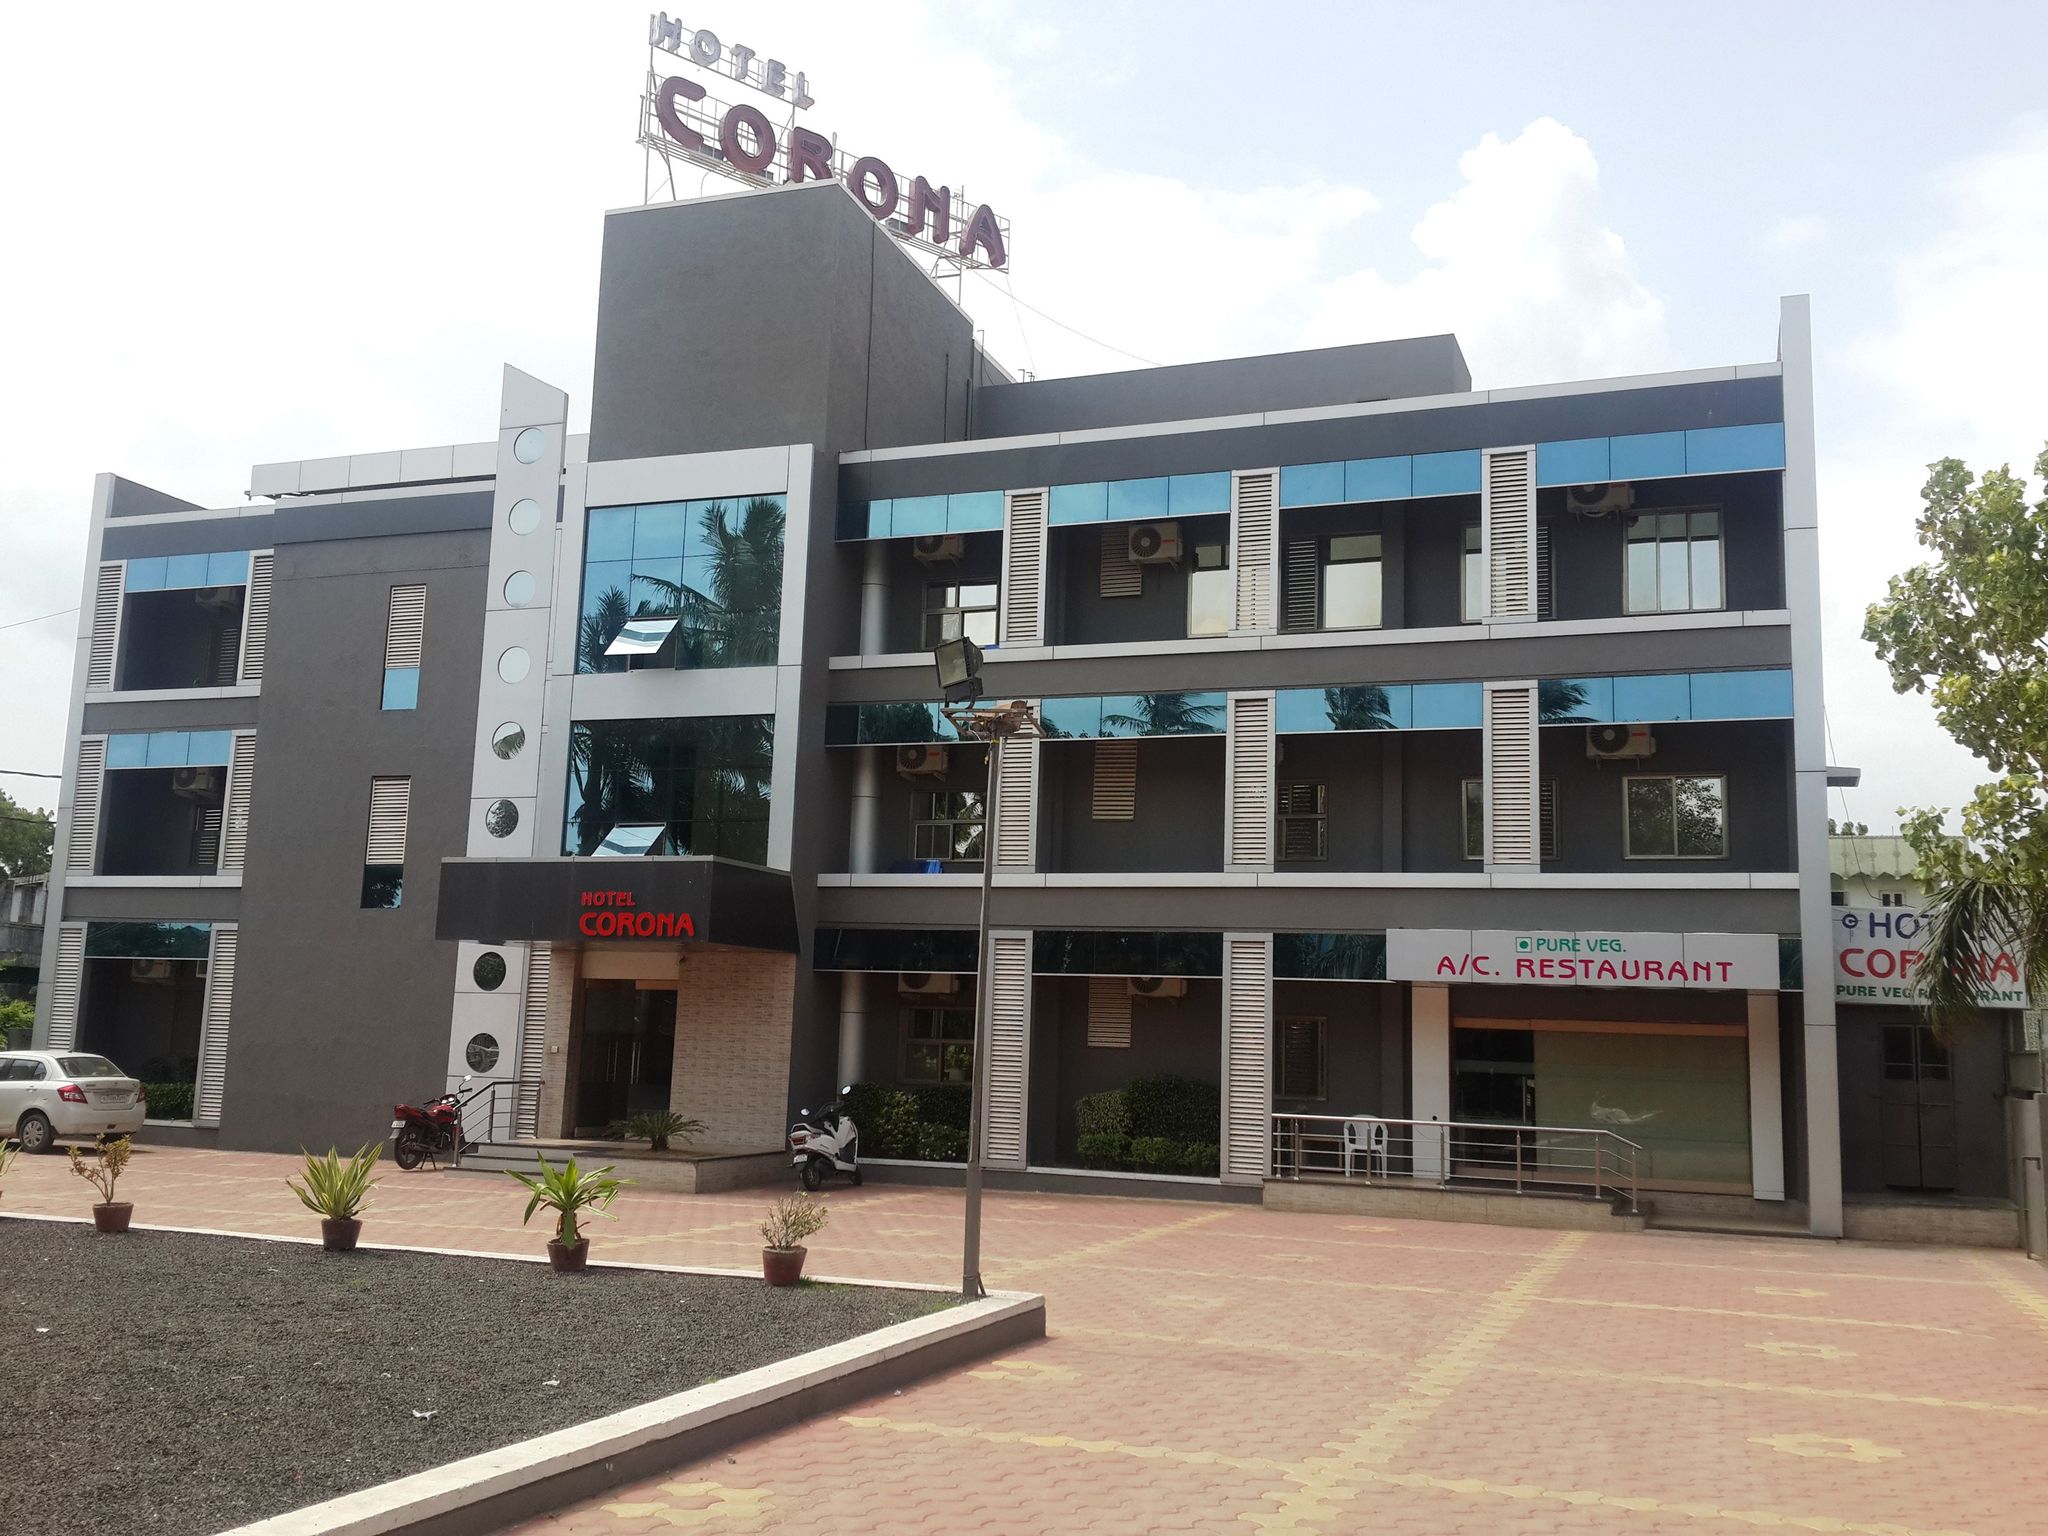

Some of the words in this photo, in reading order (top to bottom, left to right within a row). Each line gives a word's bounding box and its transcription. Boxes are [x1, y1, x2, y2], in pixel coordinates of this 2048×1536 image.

[651, 11, 815, 110] HOTEL
[655, 76, 1006, 268] CORONA
[580, 890, 636, 907] HOTEL
[578, 911, 695, 937] CORONA
[1536, 938, 1580, 952] PURE
[1586, 938, 1626, 953] VEG.
[1436, 953, 1500, 977] A/C.
[1515, 958, 1734, 983] RESTAURANT
[1839, 948, 2020, 983] CORNA
[1836, 985, 1878, 997] PURE
